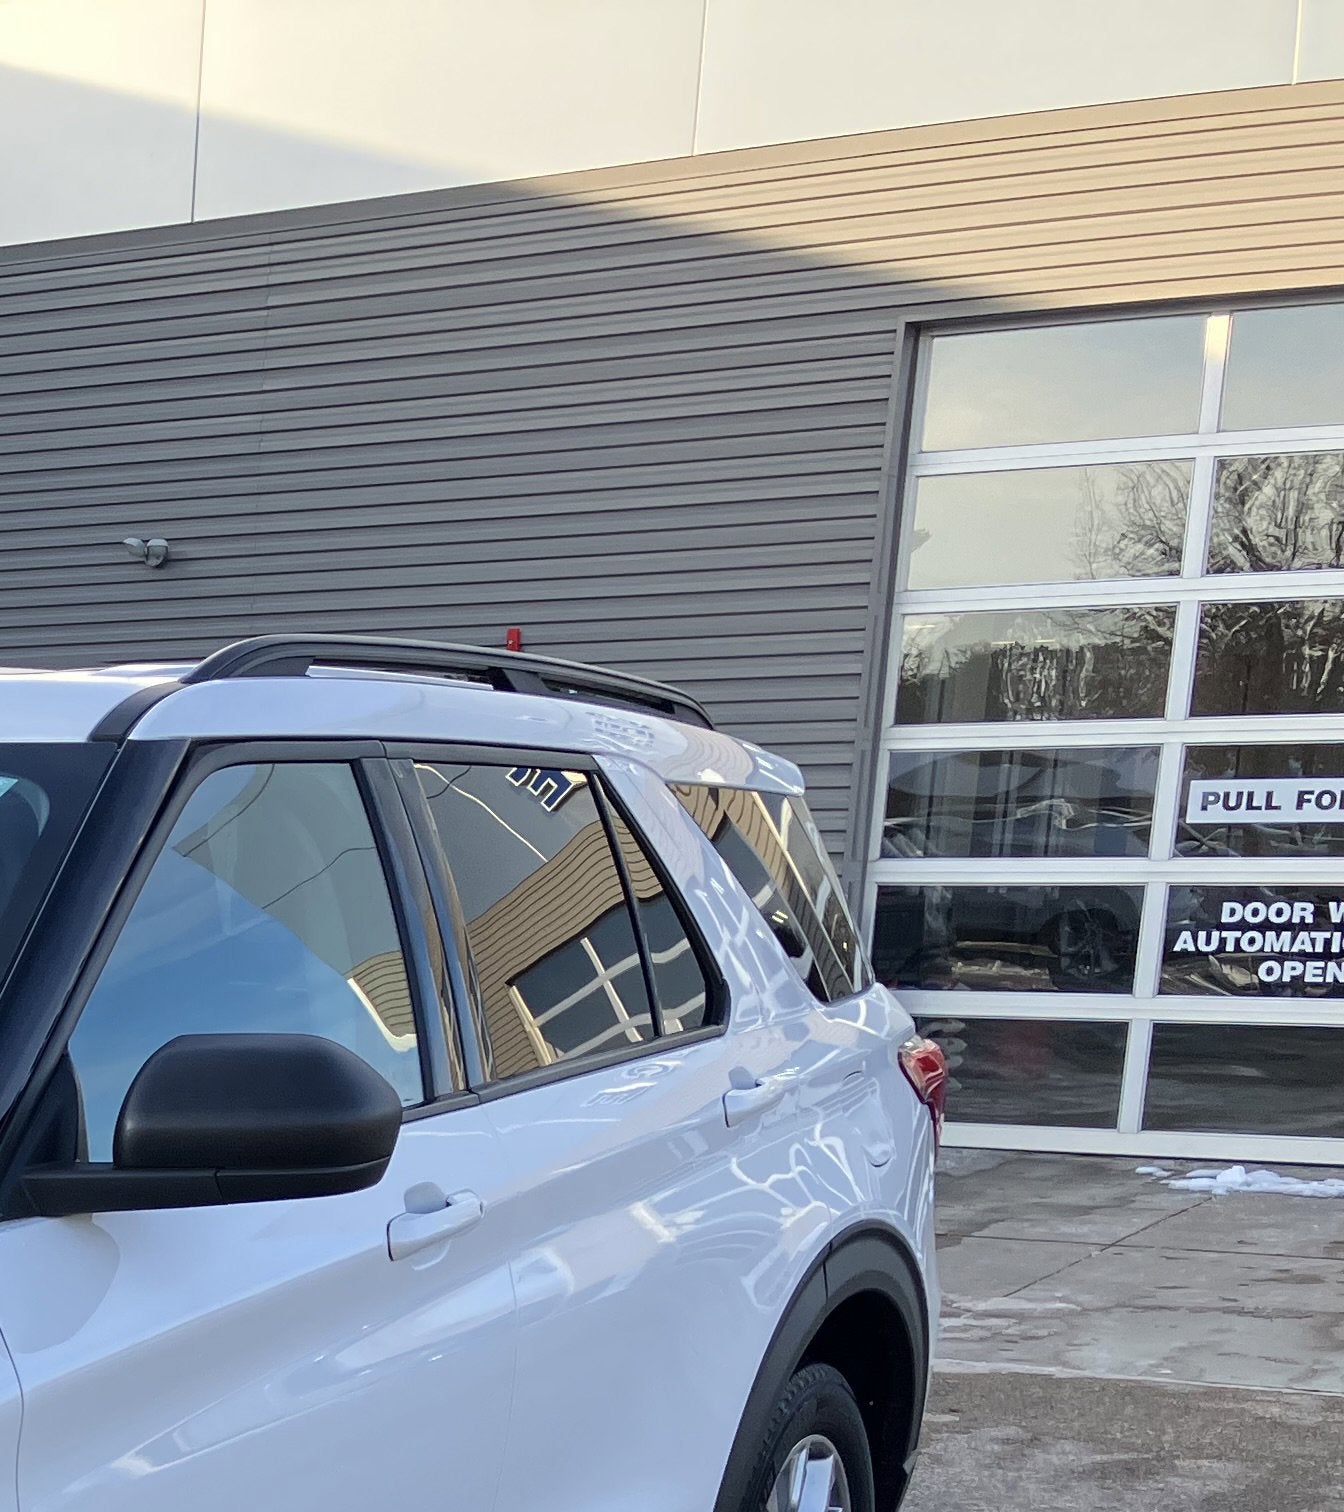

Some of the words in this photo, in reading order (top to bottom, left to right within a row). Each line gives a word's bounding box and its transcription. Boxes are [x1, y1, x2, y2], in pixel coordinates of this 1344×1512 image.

[1200, 790, 1282, 811] PULL
[1296, 789, 1344, 811] FO
[1220, 902, 1315, 924] DOOR
[1173, 931, 1344, 953] AUTOMATI
[1257, 960, 1344, 983] OPEN
